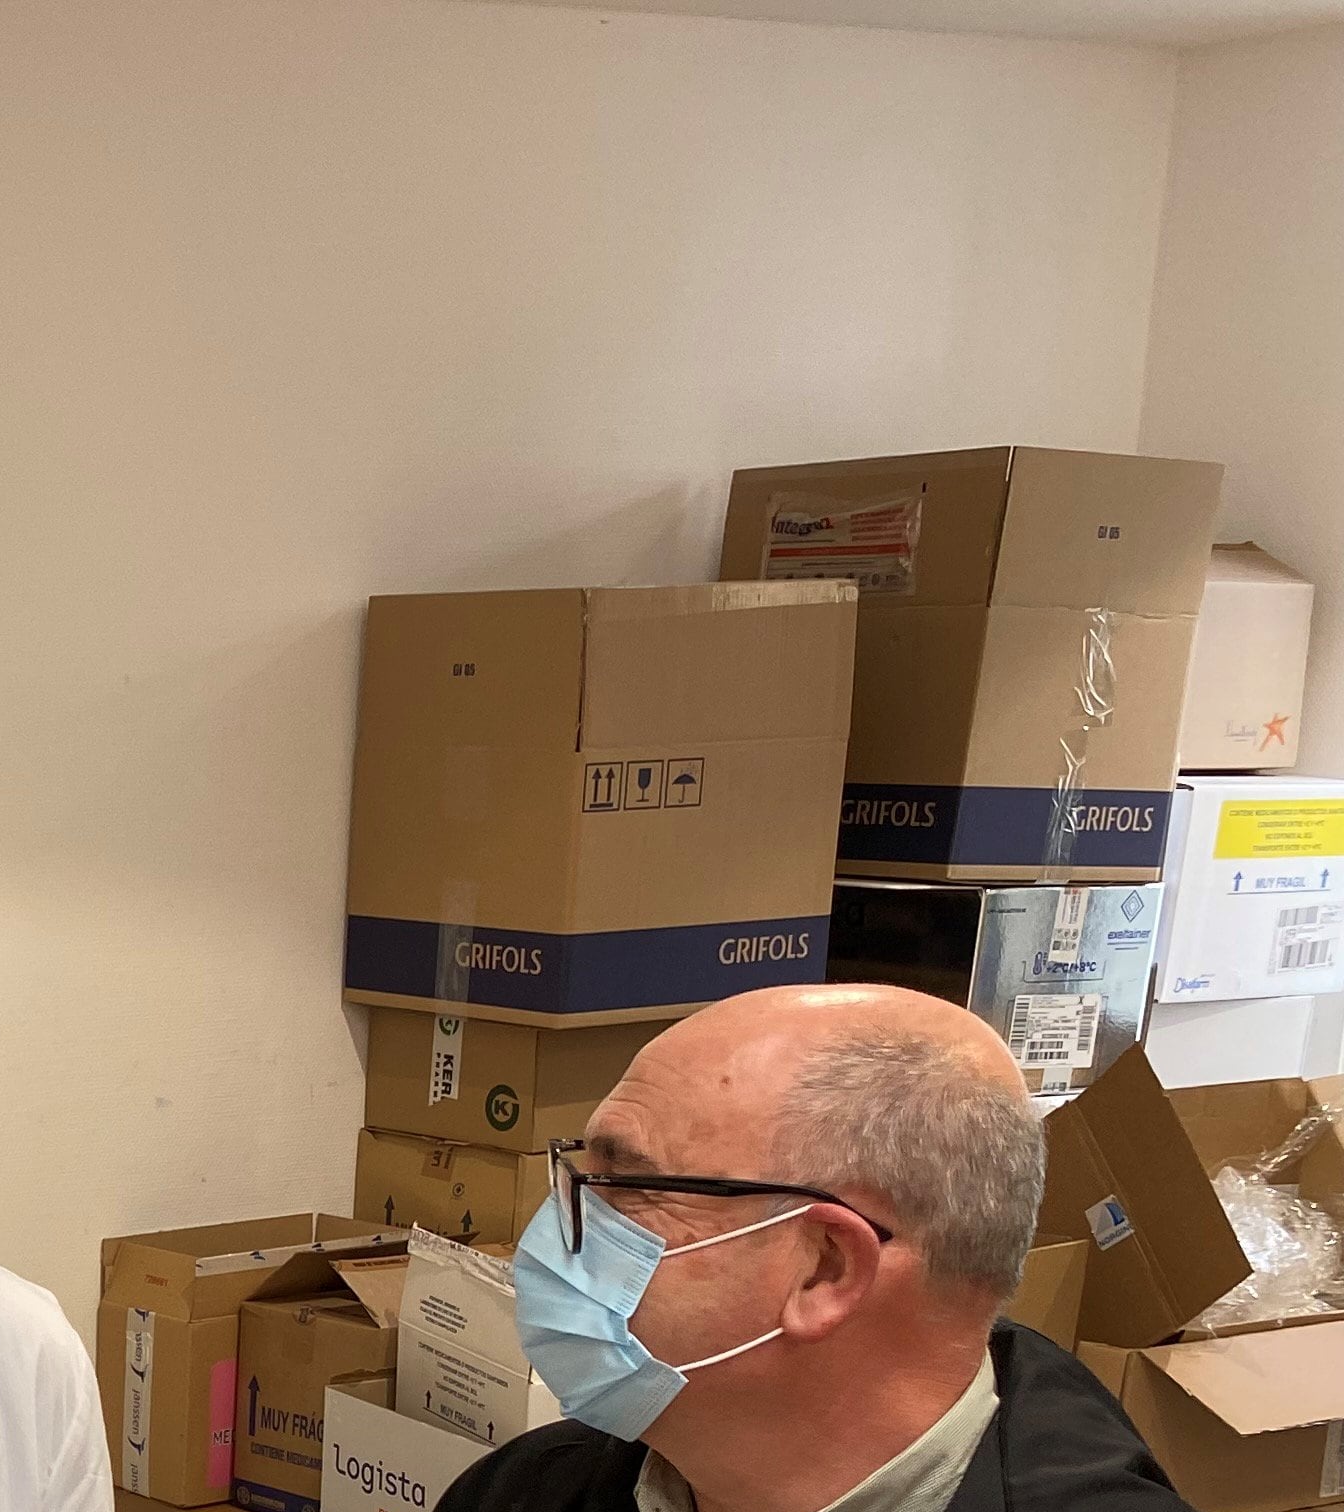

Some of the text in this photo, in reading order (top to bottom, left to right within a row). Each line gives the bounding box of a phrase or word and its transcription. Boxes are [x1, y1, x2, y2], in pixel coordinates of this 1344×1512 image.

[842, 800, 936, 828] GRIFOLS
[1075, 805, 1154, 832] GRIFOLS
[454, 941, 543, 976] GRIFOLS
[719, 933, 809, 966] GRIFOLS
[441, 1053, 454, 1097] KER
[260, 1406, 324, 1444] MUY FRÁG
